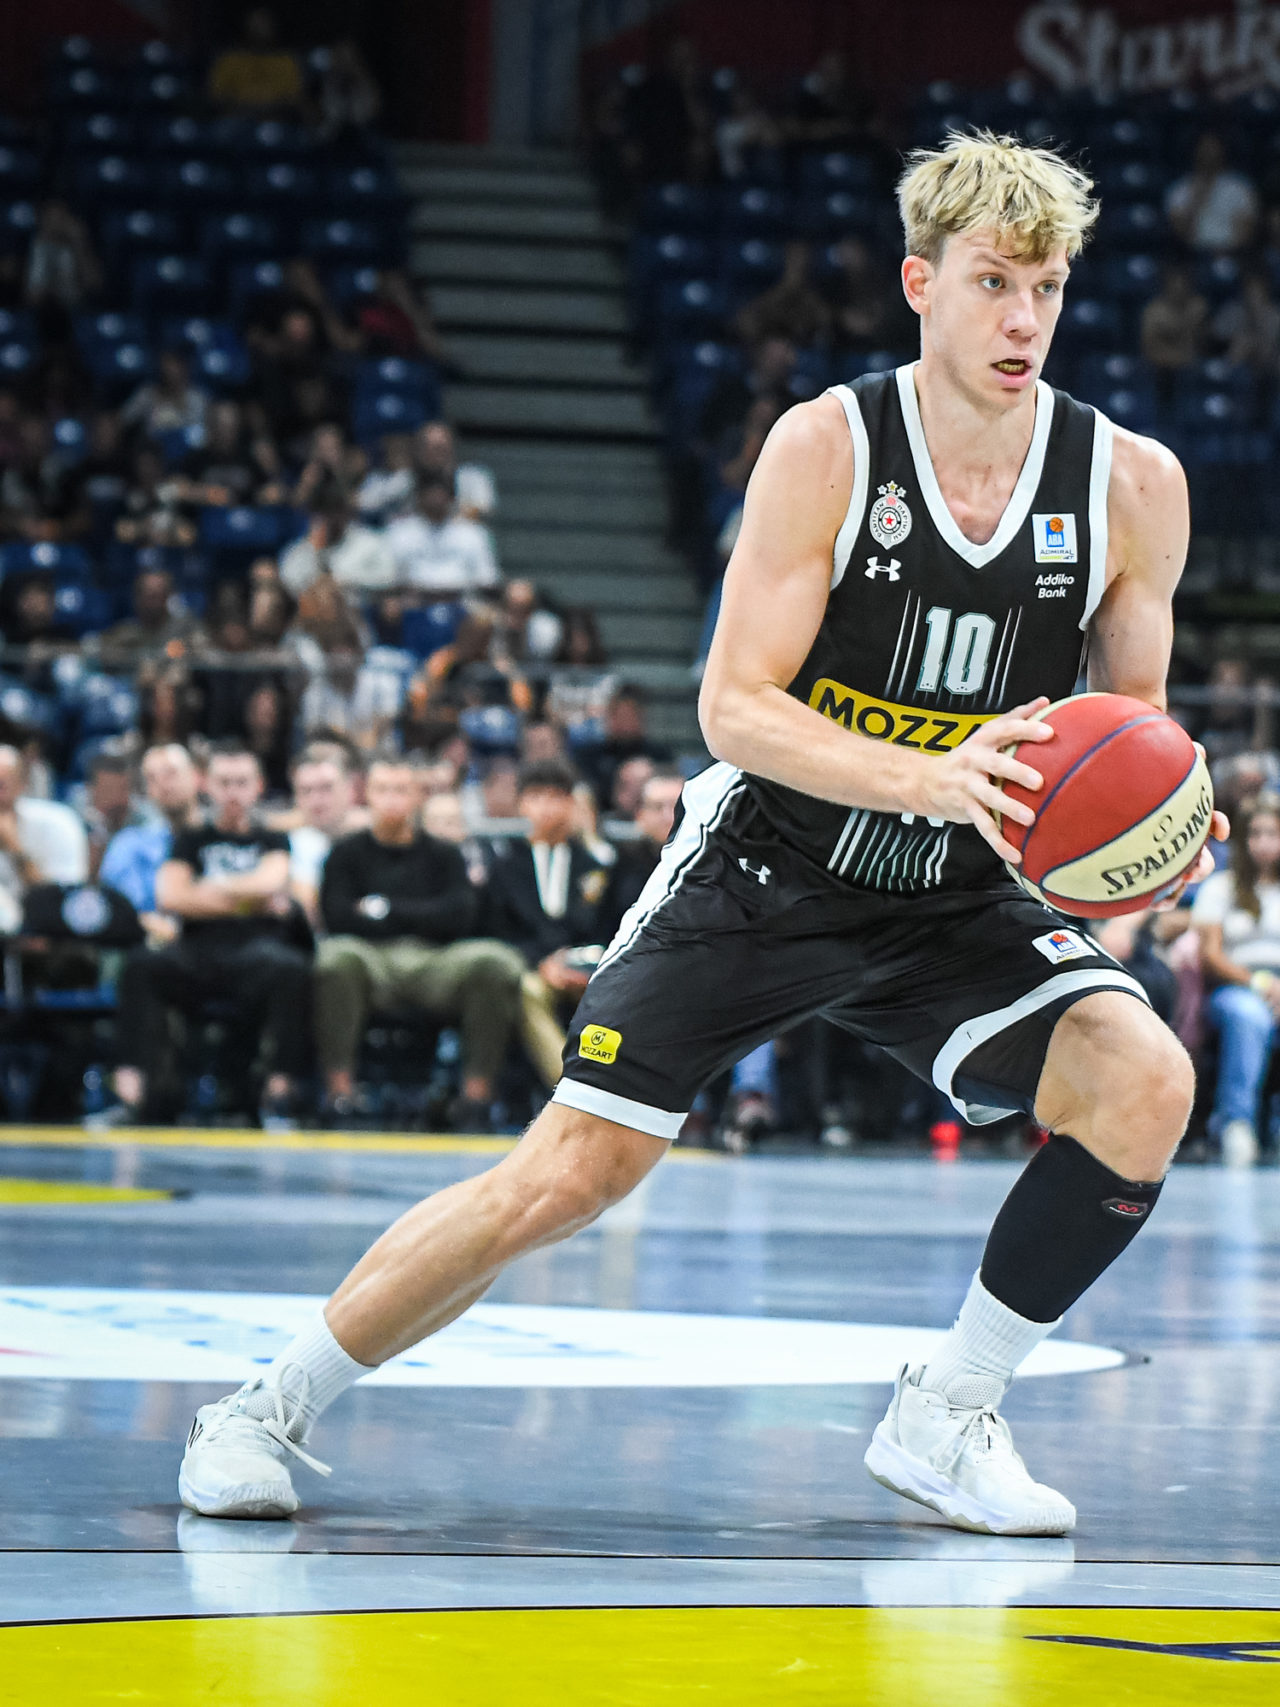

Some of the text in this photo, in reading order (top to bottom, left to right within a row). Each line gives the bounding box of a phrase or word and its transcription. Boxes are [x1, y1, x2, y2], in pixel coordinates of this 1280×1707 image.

[1035, 573, 1075, 586] Addiko
[1038, 587, 1066, 599] Bank
[916, 606, 997, 695] 10
[1101, 784, 1212, 895] SPALDING
